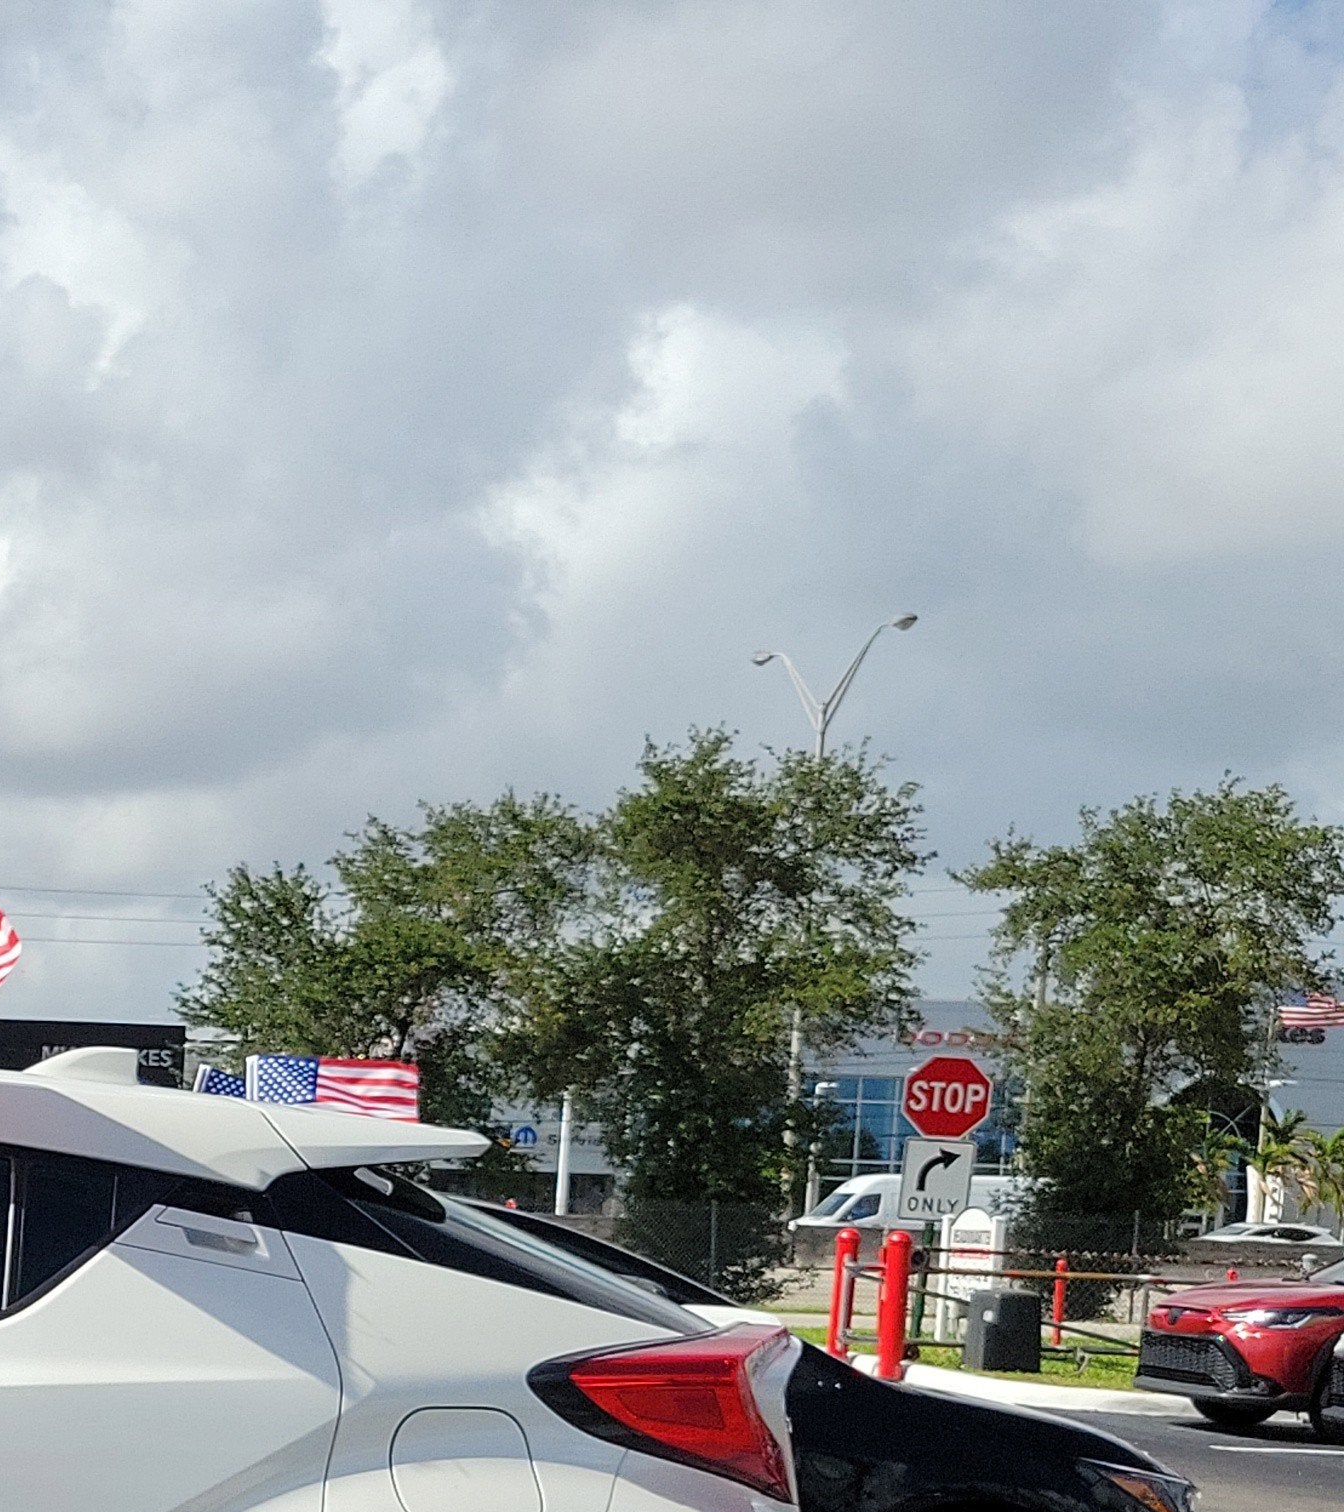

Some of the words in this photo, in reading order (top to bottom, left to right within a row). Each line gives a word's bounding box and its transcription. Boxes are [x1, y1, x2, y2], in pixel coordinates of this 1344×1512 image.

[138, 1049, 174, 1067] KES
[909, 1079, 986, 1114] STOP
[907, 1196, 959, 1214] ONLY
